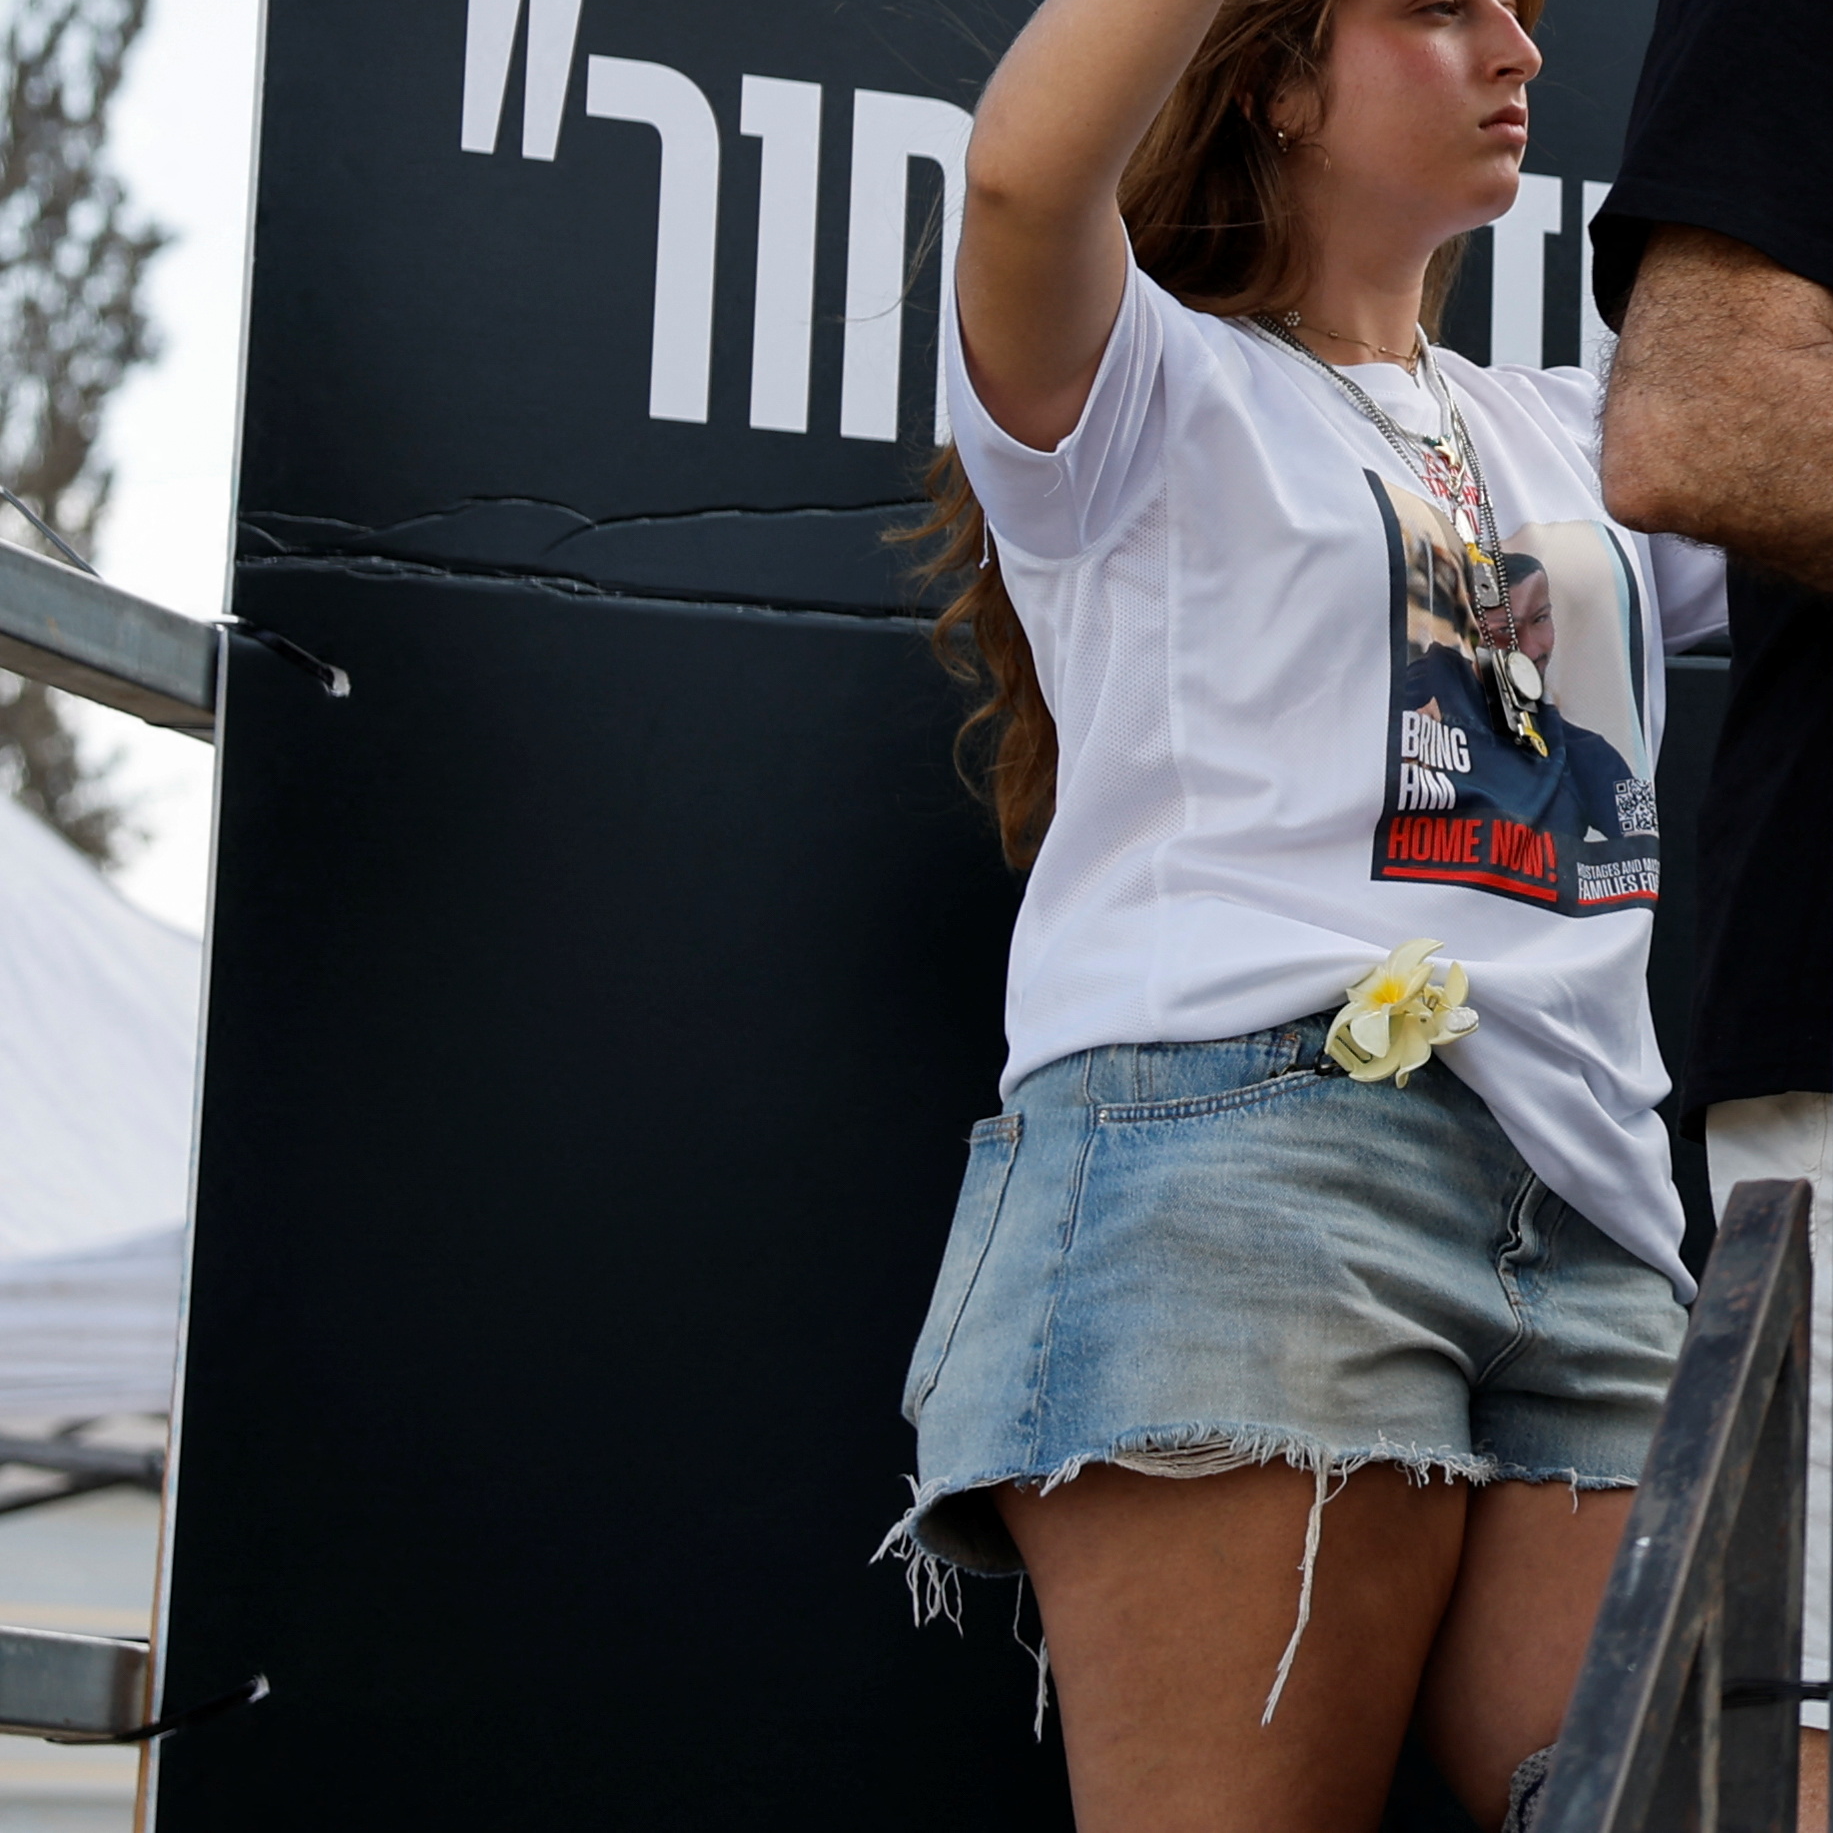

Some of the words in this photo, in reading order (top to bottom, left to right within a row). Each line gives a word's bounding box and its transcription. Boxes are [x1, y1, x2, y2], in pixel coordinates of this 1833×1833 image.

[1401, 710, 1471, 773] BRING
[1397, 763, 1456, 810] HIM
[1387, 817, 1484, 863] HOME
[1489, 819, 1558, 883] NOW!
[1621, 858, 1642, 875] AND
[1578, 874, 1638, 900] FAMILIES
